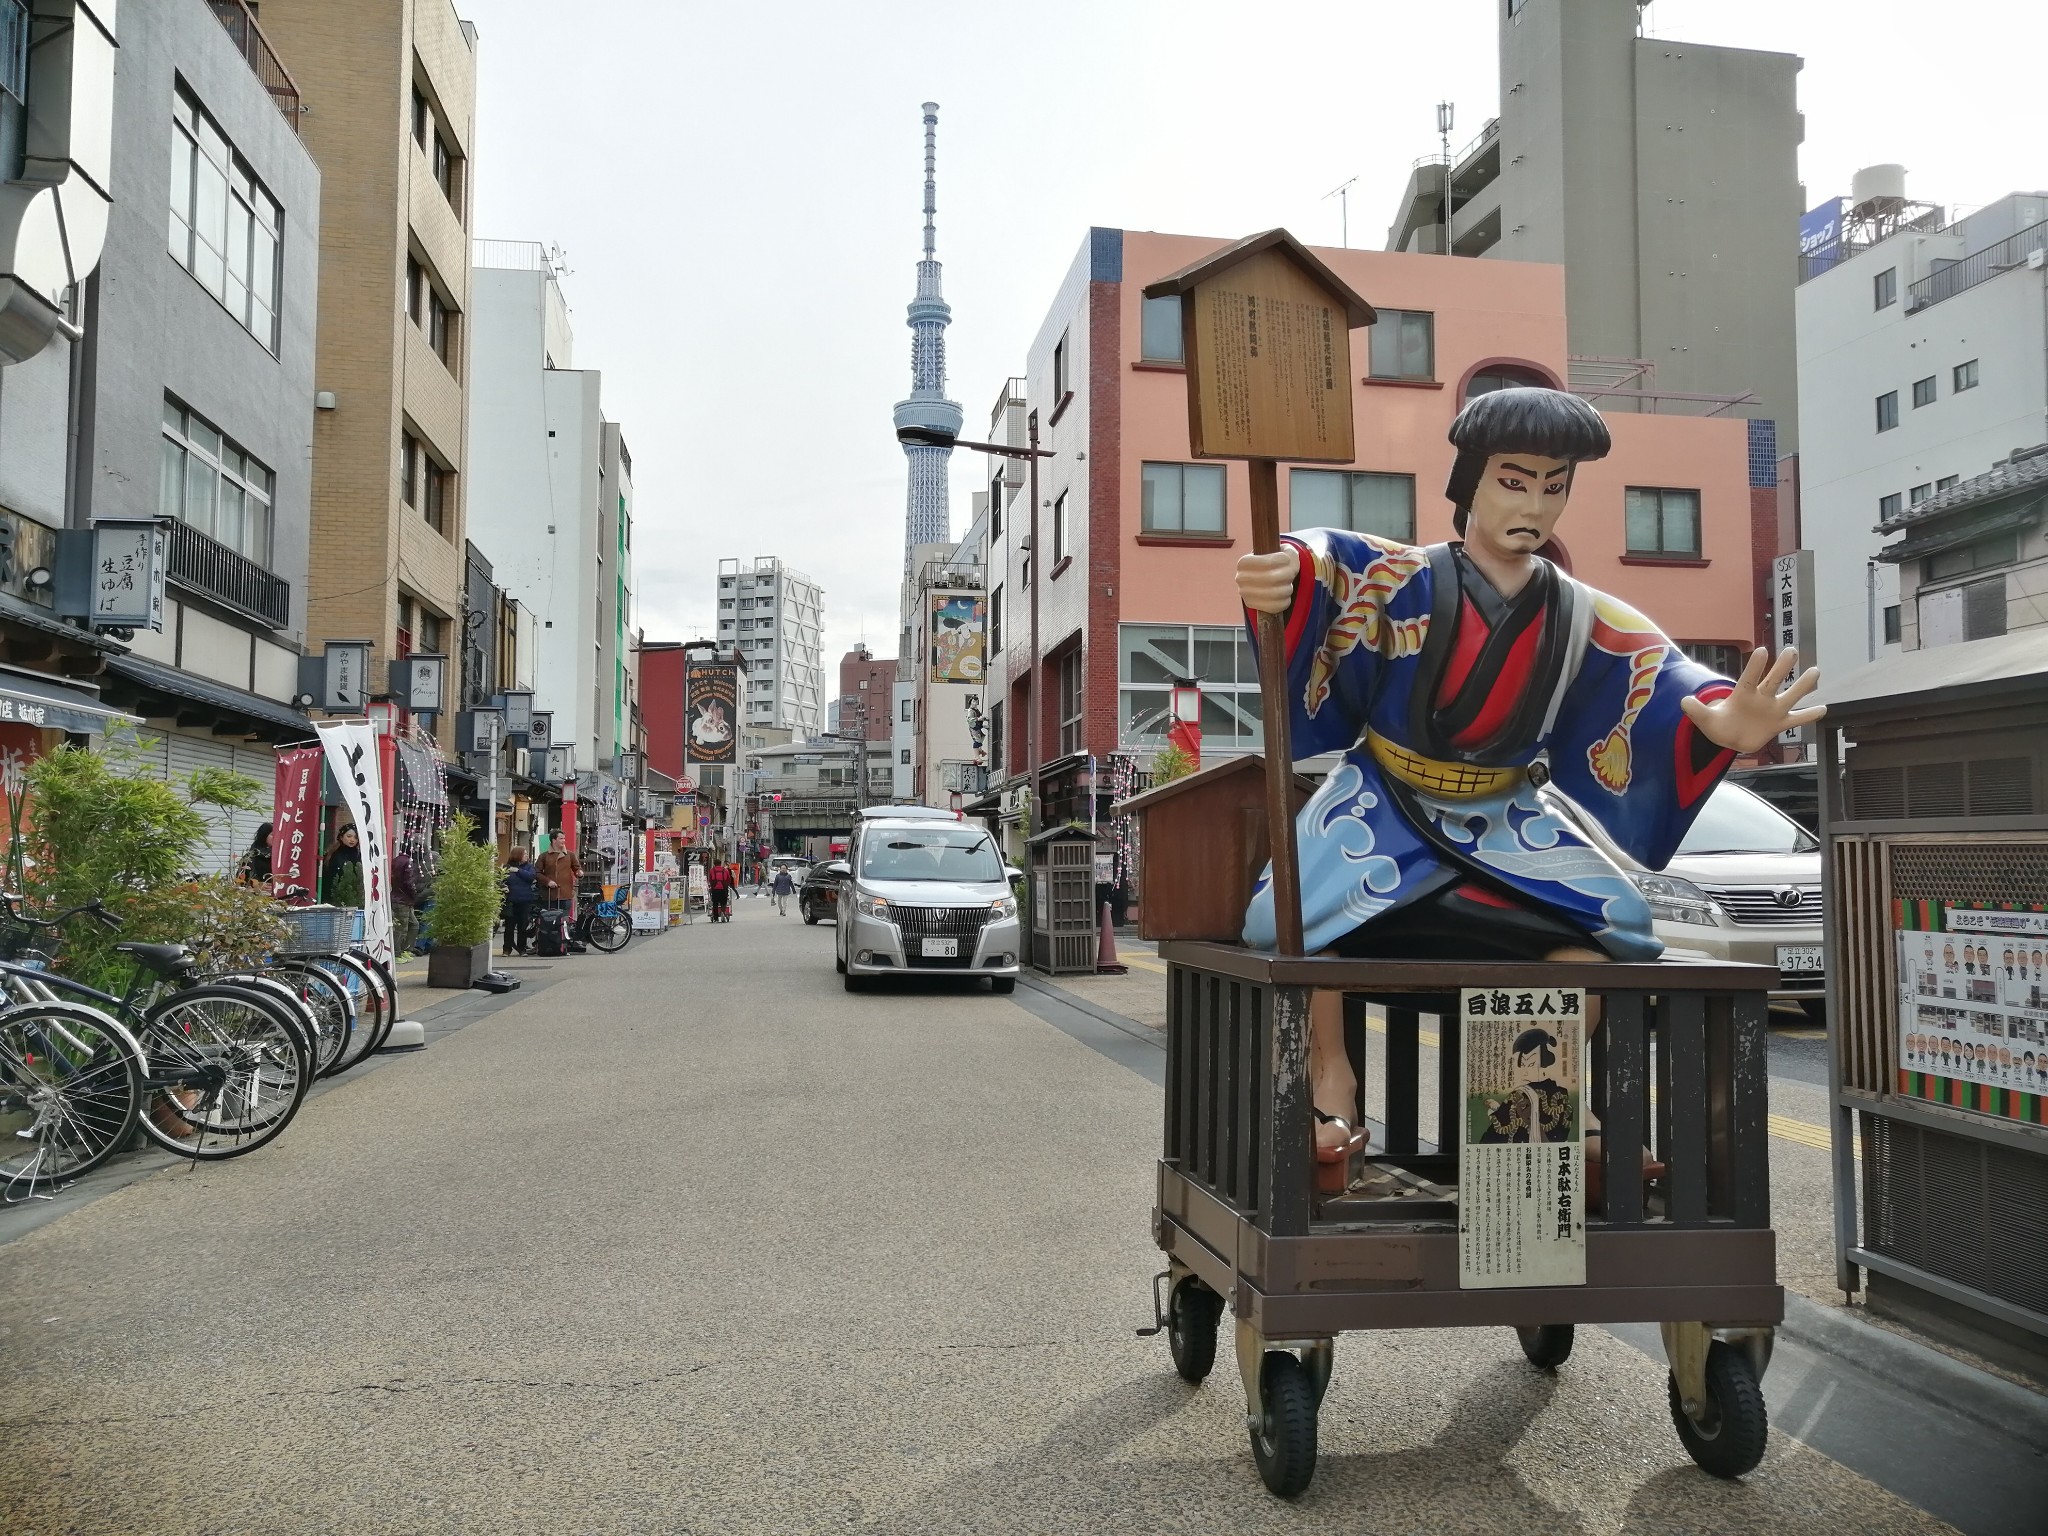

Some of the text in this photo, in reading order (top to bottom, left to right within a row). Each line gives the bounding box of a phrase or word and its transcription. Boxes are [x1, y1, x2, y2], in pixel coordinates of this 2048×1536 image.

[136, 533, 147, 571] 手作り
[100, 557, 119, 612] 生ゆば
[117, 554, 134, 591] 豆腐
[551, 753, 559, 776] 丸井
[1787, 956, 1822, 970] 97-94
[1468, 993, 1579, 1015] 白浪五人男
[1558, 1146, 1571, 1239] 日本駄右衛門
